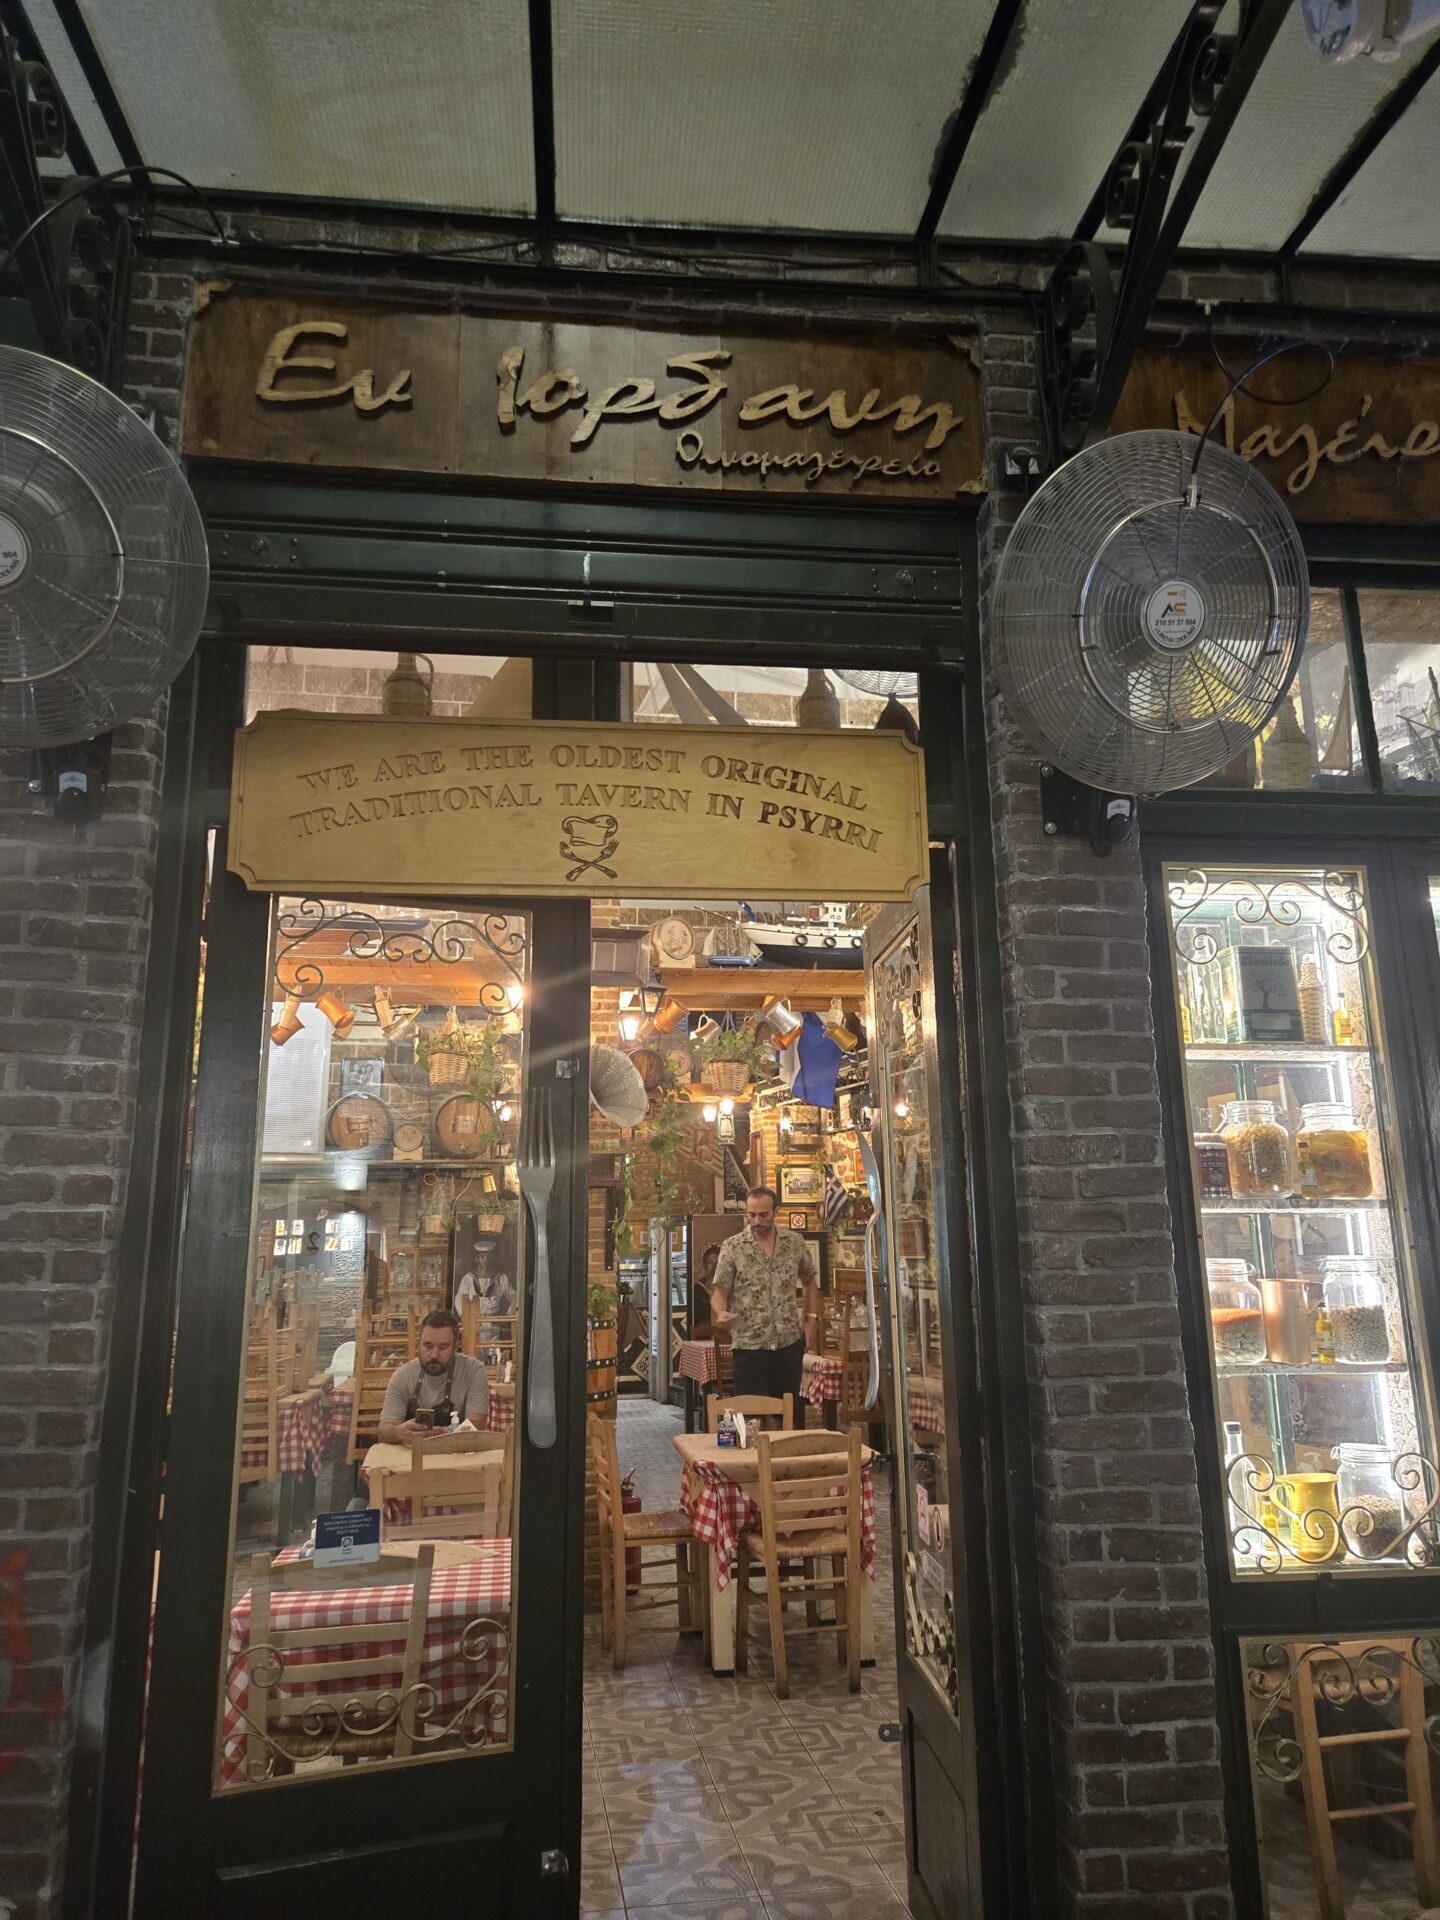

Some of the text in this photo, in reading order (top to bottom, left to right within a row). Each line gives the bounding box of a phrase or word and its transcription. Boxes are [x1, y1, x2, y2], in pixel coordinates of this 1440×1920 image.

[297, 744, 868, 812] WE ARE THE OLDEST ORIGINAL
[288, 783, 884, 853] TRADITIONAL TAVERN IN PSYRRI
